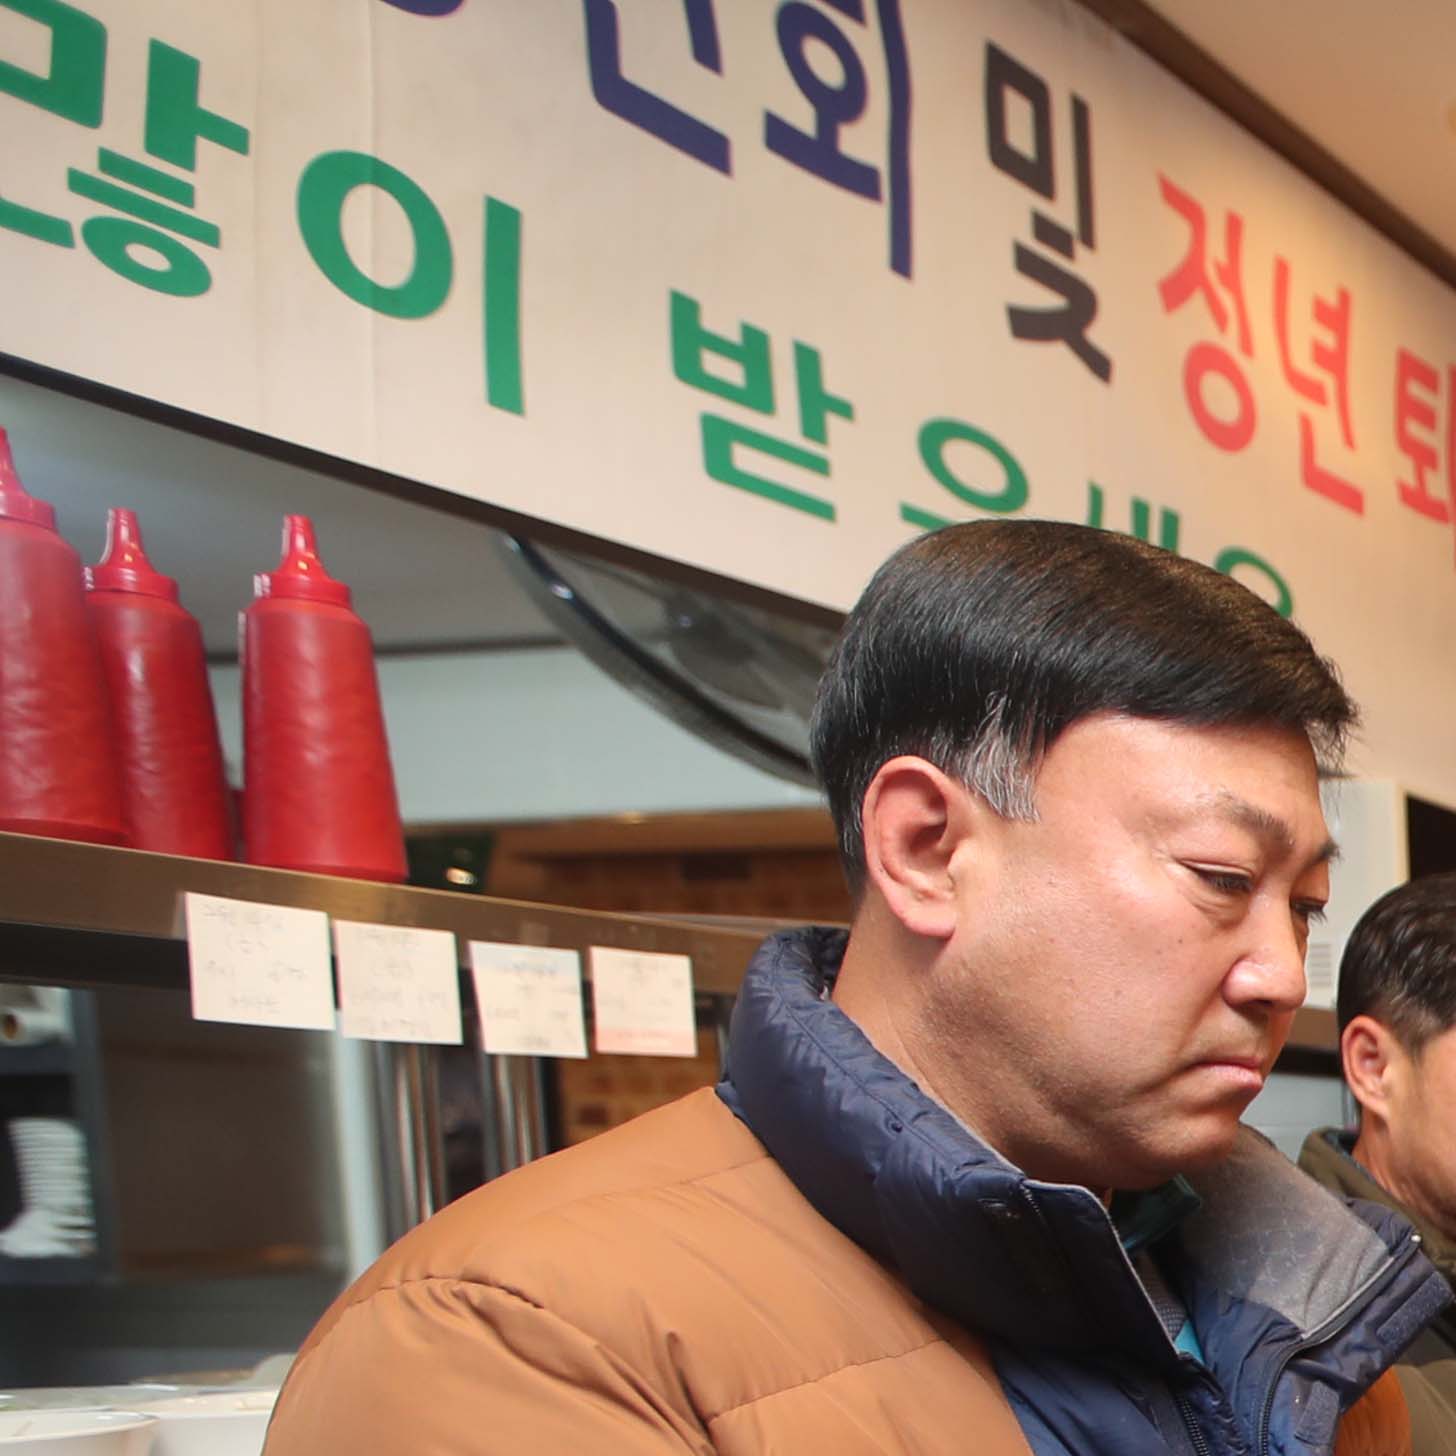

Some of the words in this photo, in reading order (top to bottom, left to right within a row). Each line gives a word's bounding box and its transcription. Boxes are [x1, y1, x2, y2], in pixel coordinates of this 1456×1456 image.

[0, 0, 526, 418] 많이
[981, 38, 1113, 387] 및
[1155, 167, 1367, 518] 정년
